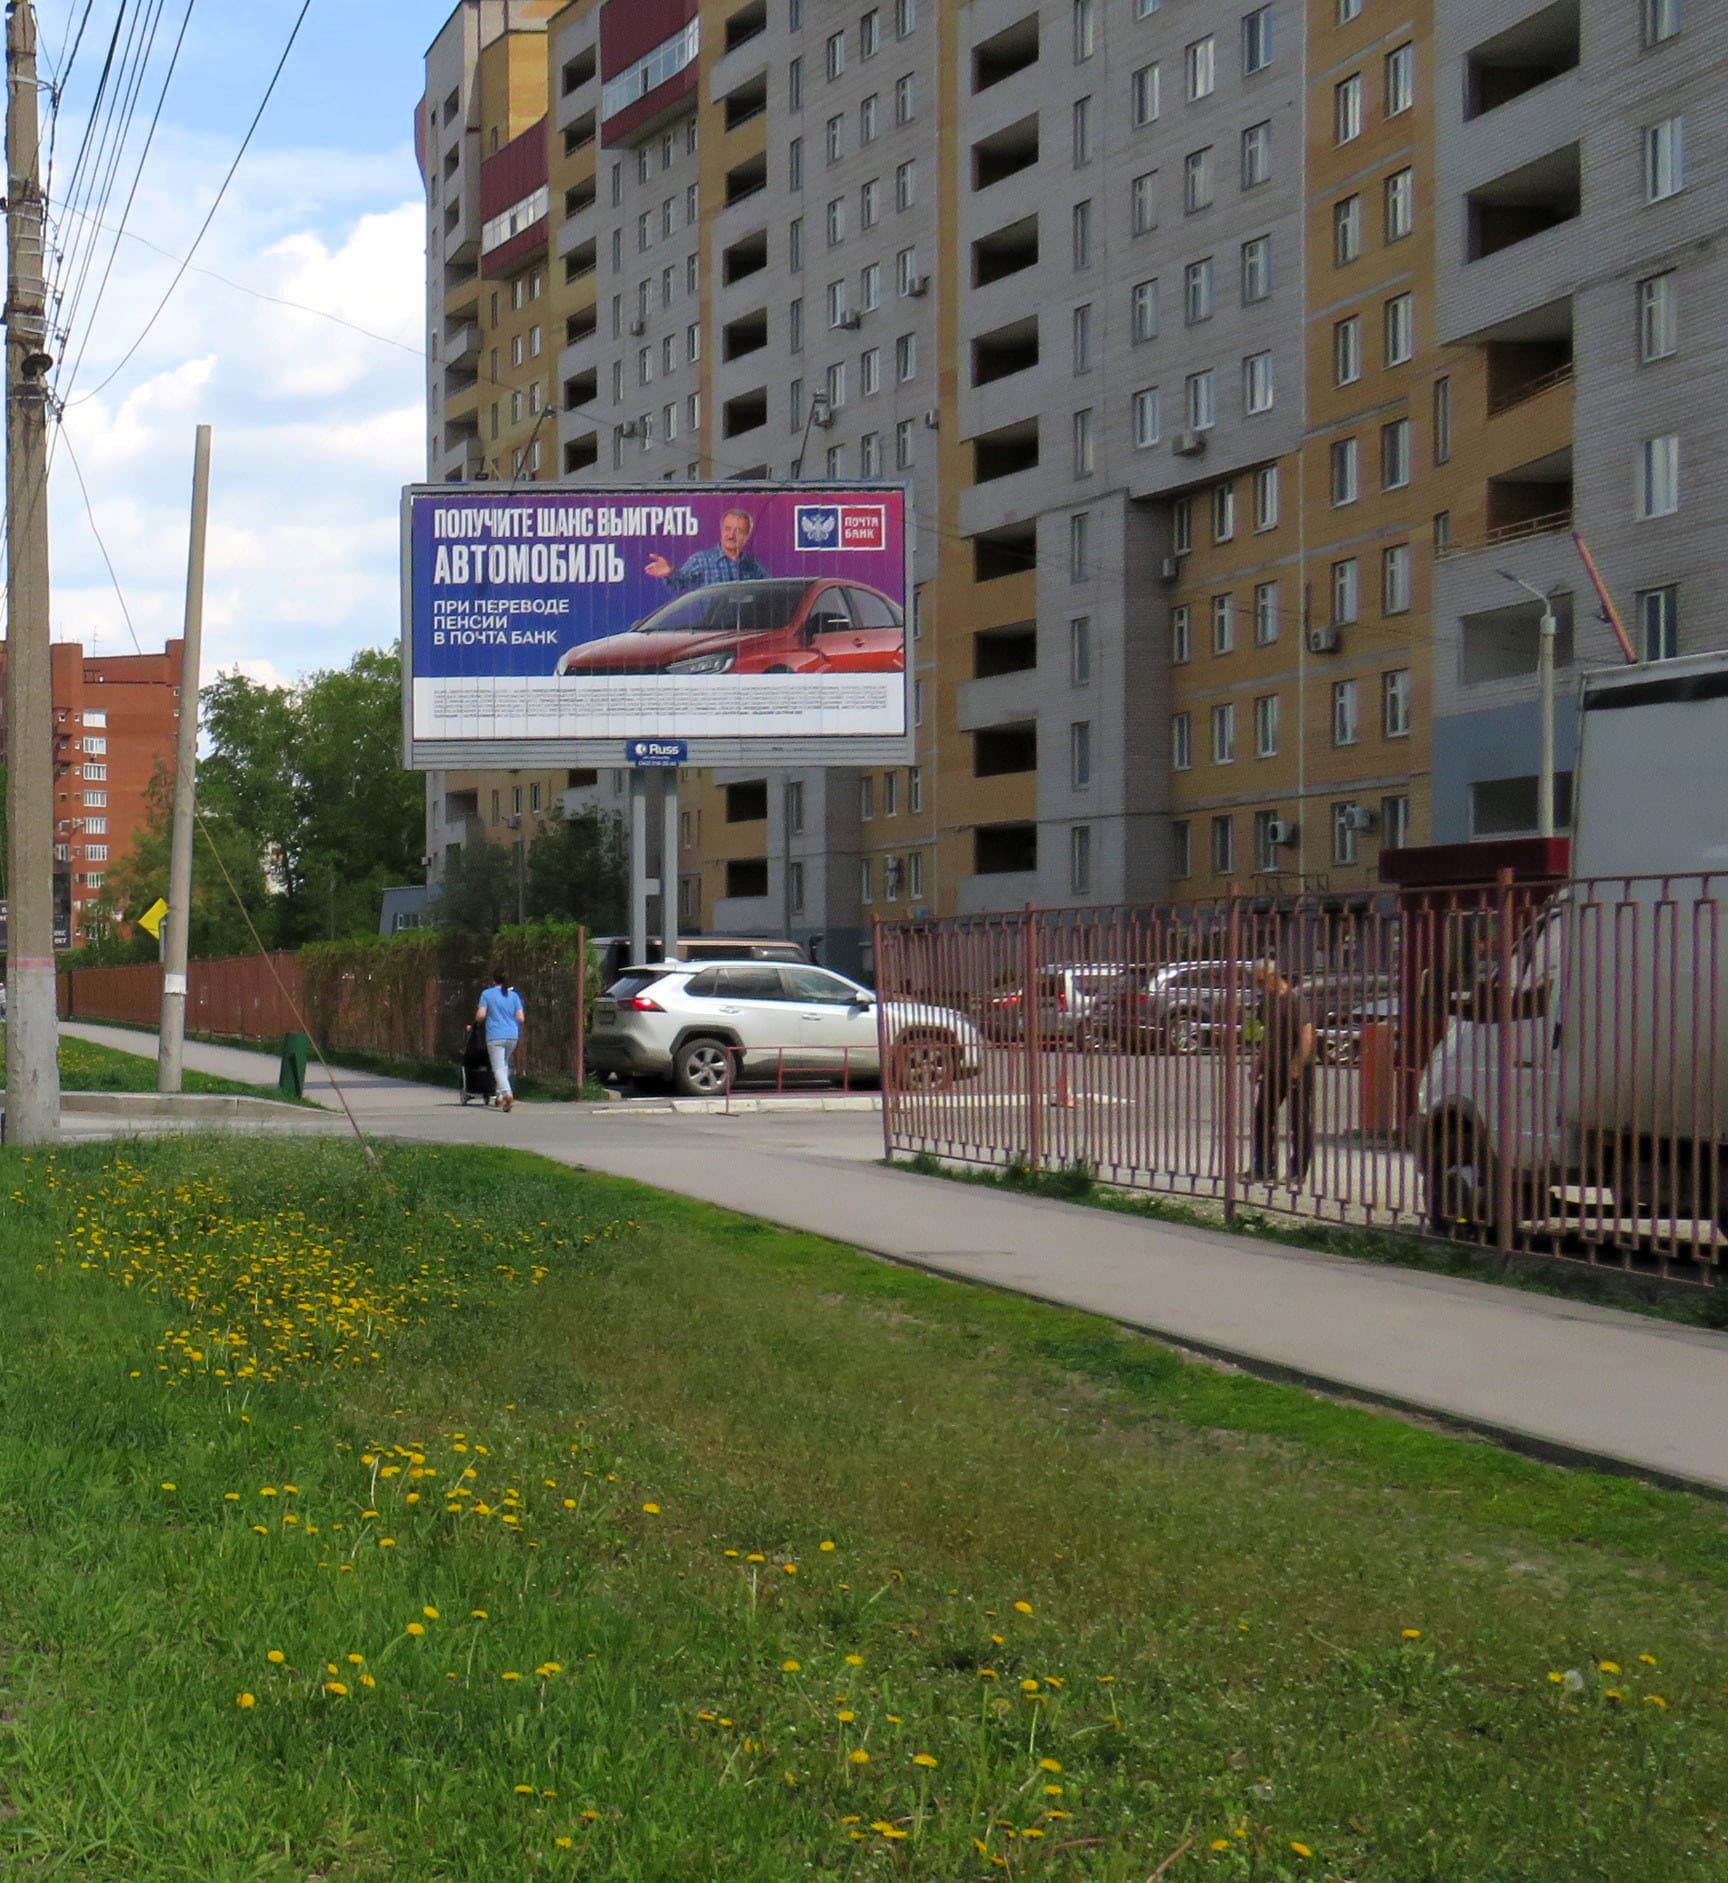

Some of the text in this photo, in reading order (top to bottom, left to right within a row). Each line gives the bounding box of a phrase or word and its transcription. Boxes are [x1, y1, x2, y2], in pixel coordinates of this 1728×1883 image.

[434, 505, 699, 538] ПОЛУЧИТЕ ШАНС ВЫИГРАТЬ
[844, 517, 879, 527] ПОЧТА
[844, 528, 875, 539] БАНК
[433, 543, 624, 584] АВТОМОБИЛЬ
[433, 598, 570, 615] ПРИ ПЕРЕВОДЕ
[433, 614, 508, 629] ПЕНСИИ
[433, 629, 558, 645] В ПОЧТА БАНК
[649, 743, 680, 756] Russ
